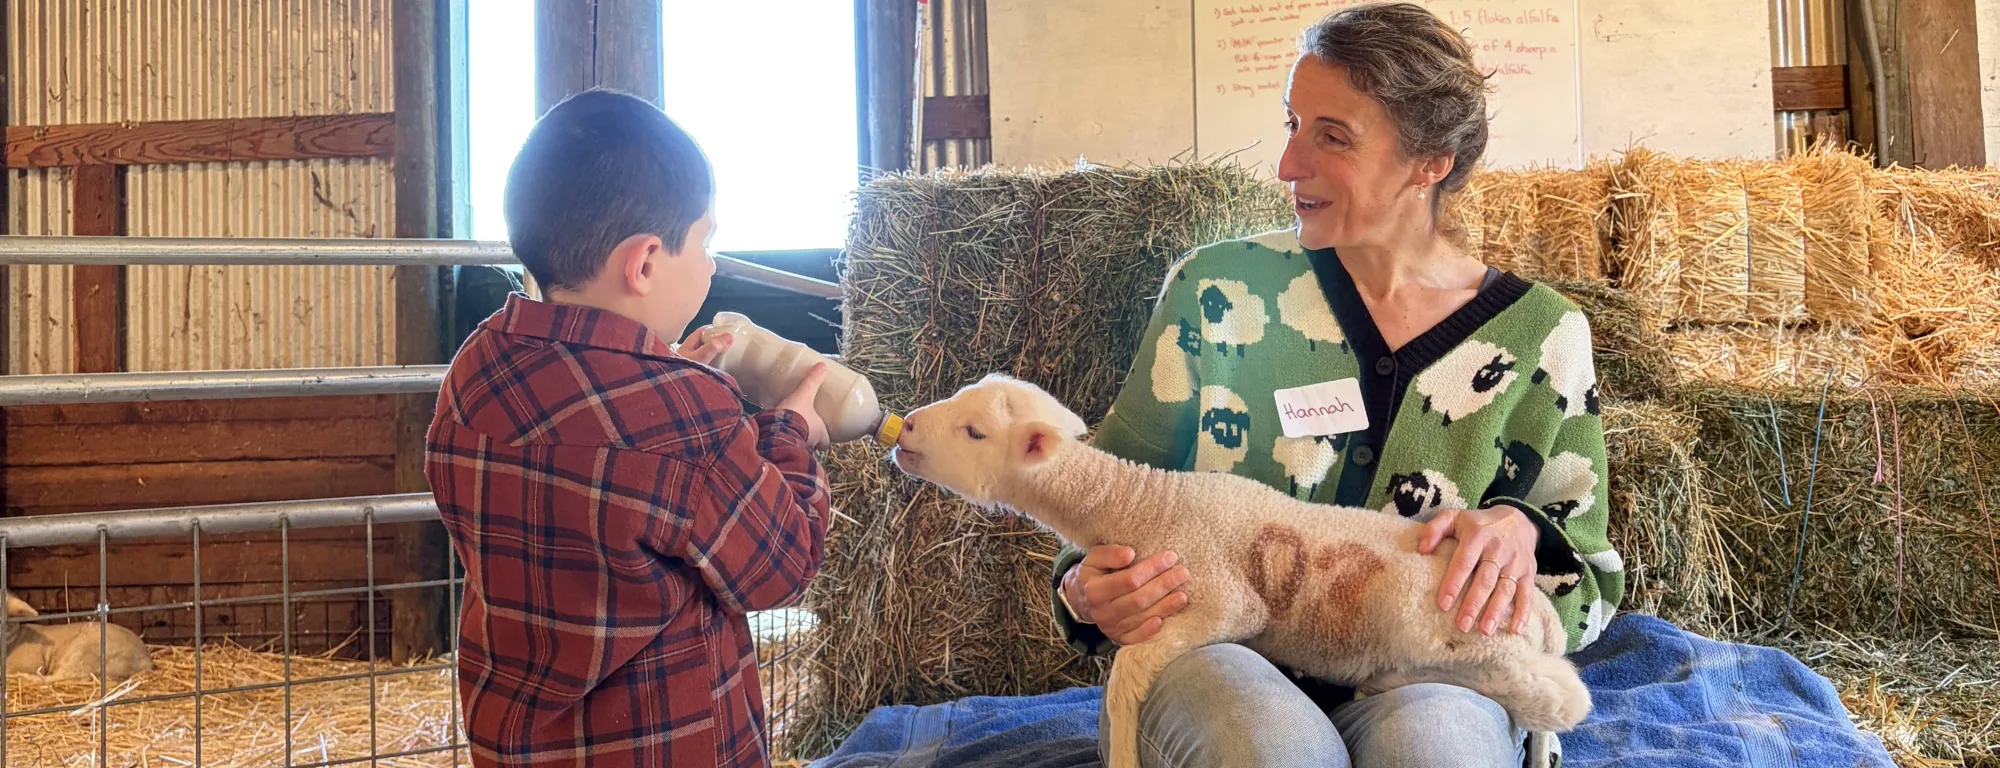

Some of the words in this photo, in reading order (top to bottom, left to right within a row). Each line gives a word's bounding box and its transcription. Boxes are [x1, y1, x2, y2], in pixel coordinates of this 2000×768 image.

[1268, 2, 1282, 12] out
[1478, 8, 1512, 25] flakes
[1516, 7, 1560, 25] alfalfa
[1483, 38, 1498, 51] of
[1503, 39, 1513, 52] 4
[1516, 41, 1548, 61] sheep
[1499, 62, 1532, 76] alfalfa
[1283, 396, 1355, 420] Hannah
